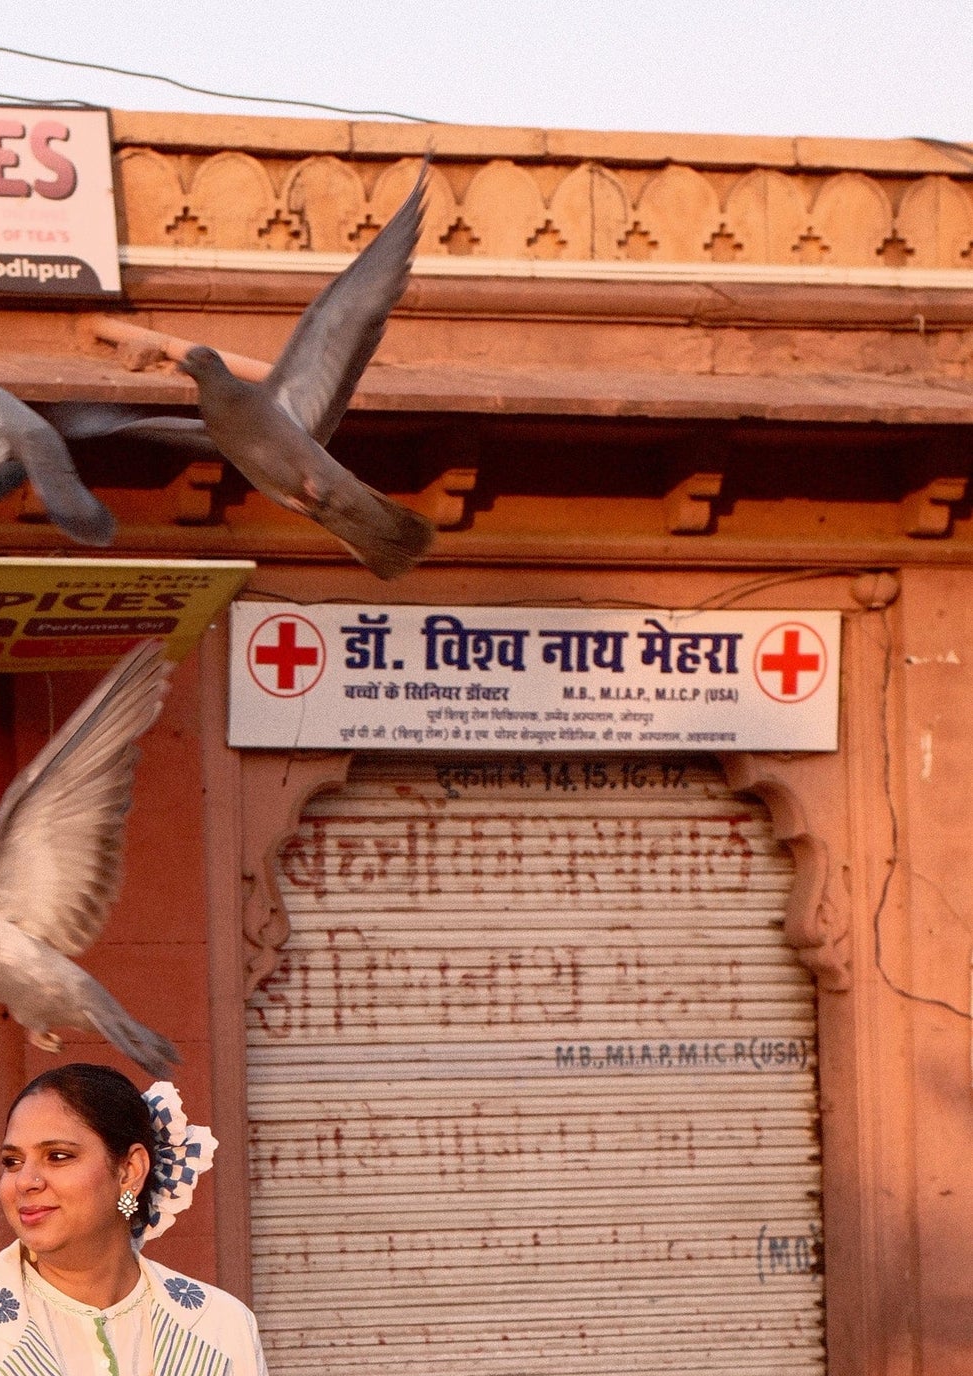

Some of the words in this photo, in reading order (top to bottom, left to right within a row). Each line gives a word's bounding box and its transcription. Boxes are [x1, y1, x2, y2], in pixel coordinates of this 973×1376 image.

[2, 228, 22, 243] OF
[36, 621, 129, 633] Perfumes
[135, 621, 165, 631] Oil
[340, 613, 405, 670] डॉ.
[420, 614, 531, 672] विश्व
[636, 618, 744, 674] मेहरा
[342, 680, 382, 700] बच्चों
[383, 681, 401, 700] के
[404, 681, 462, 701] सिनियर
[562, 686, 596, 702] M.B.,
[704, 687, 740, 704] (USA)
